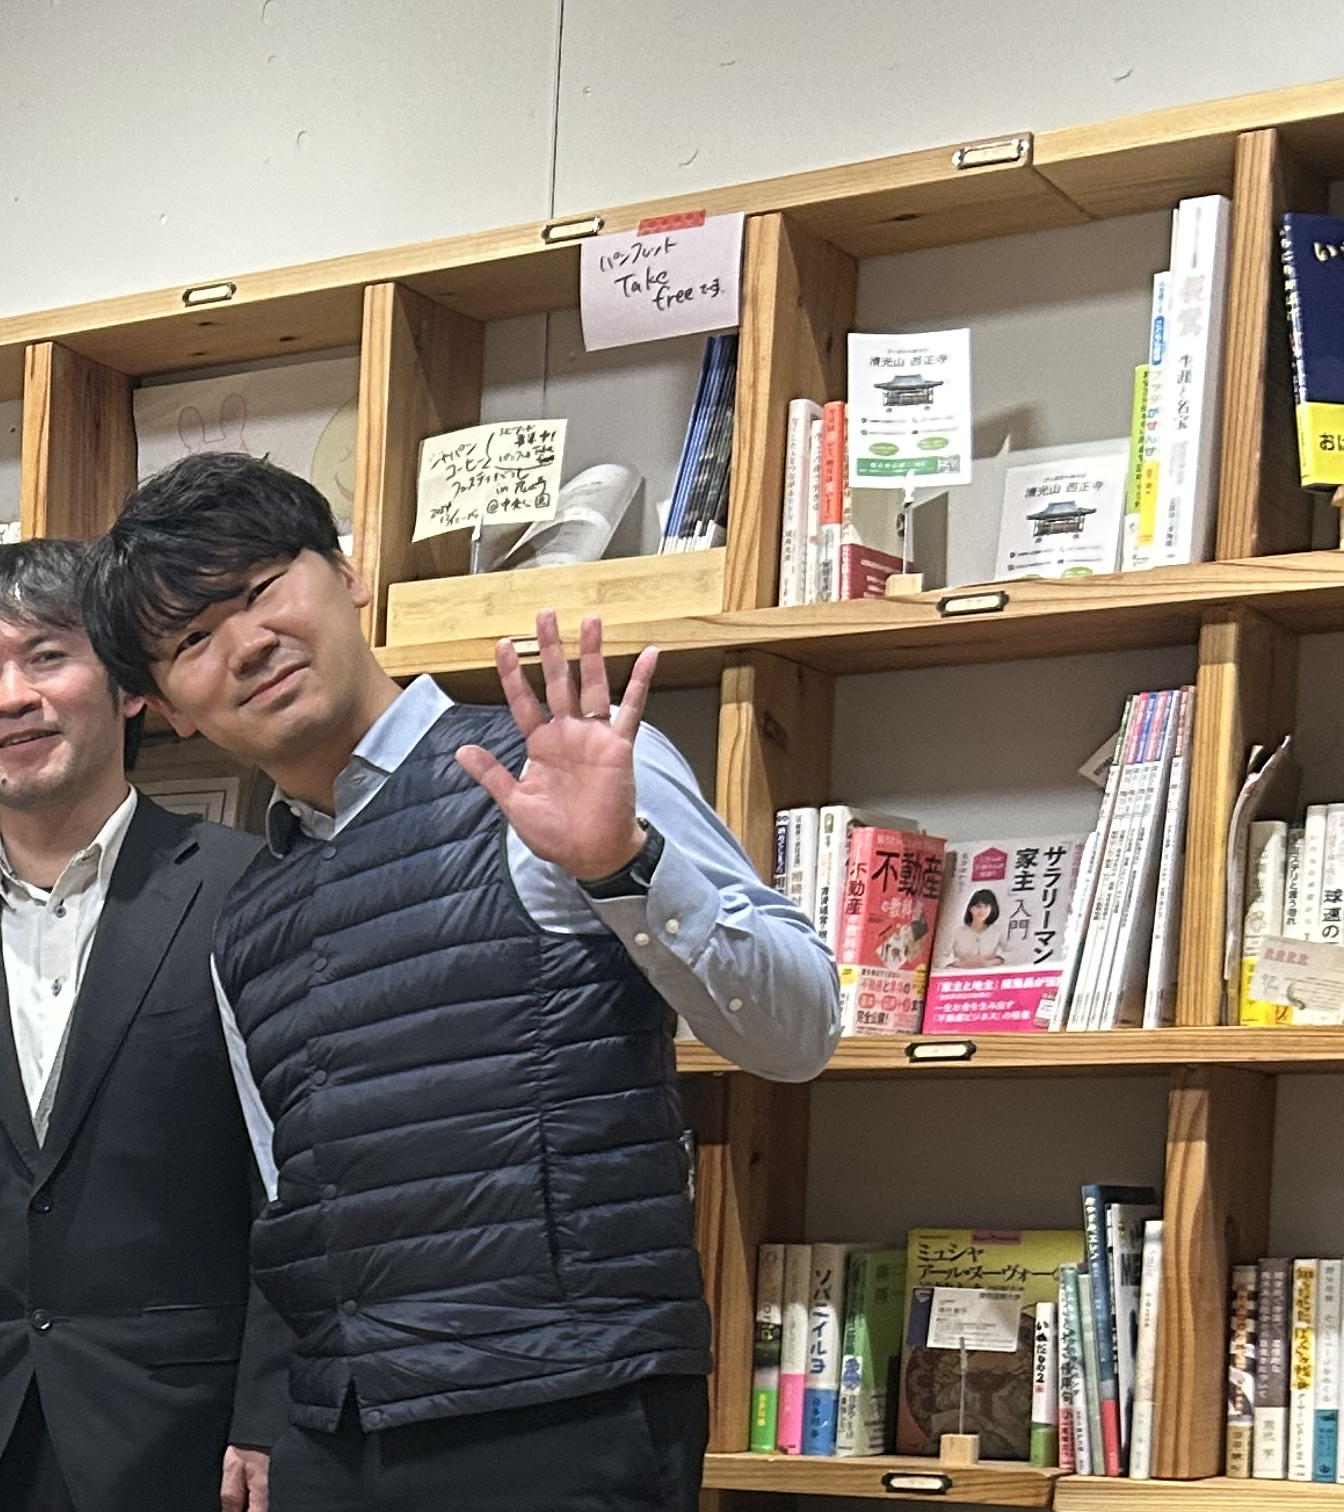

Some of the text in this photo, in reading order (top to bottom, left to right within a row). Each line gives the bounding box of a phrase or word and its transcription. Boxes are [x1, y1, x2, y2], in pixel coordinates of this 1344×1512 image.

[614, 267, 669, 298] Take
[652, 285, 693, 311] free
[872, 849, 945, 900] 不動産
[917, 1242, 985, 1263] ミュシャ
[809, 1268, 832, 1374] ソバニイルヨ
